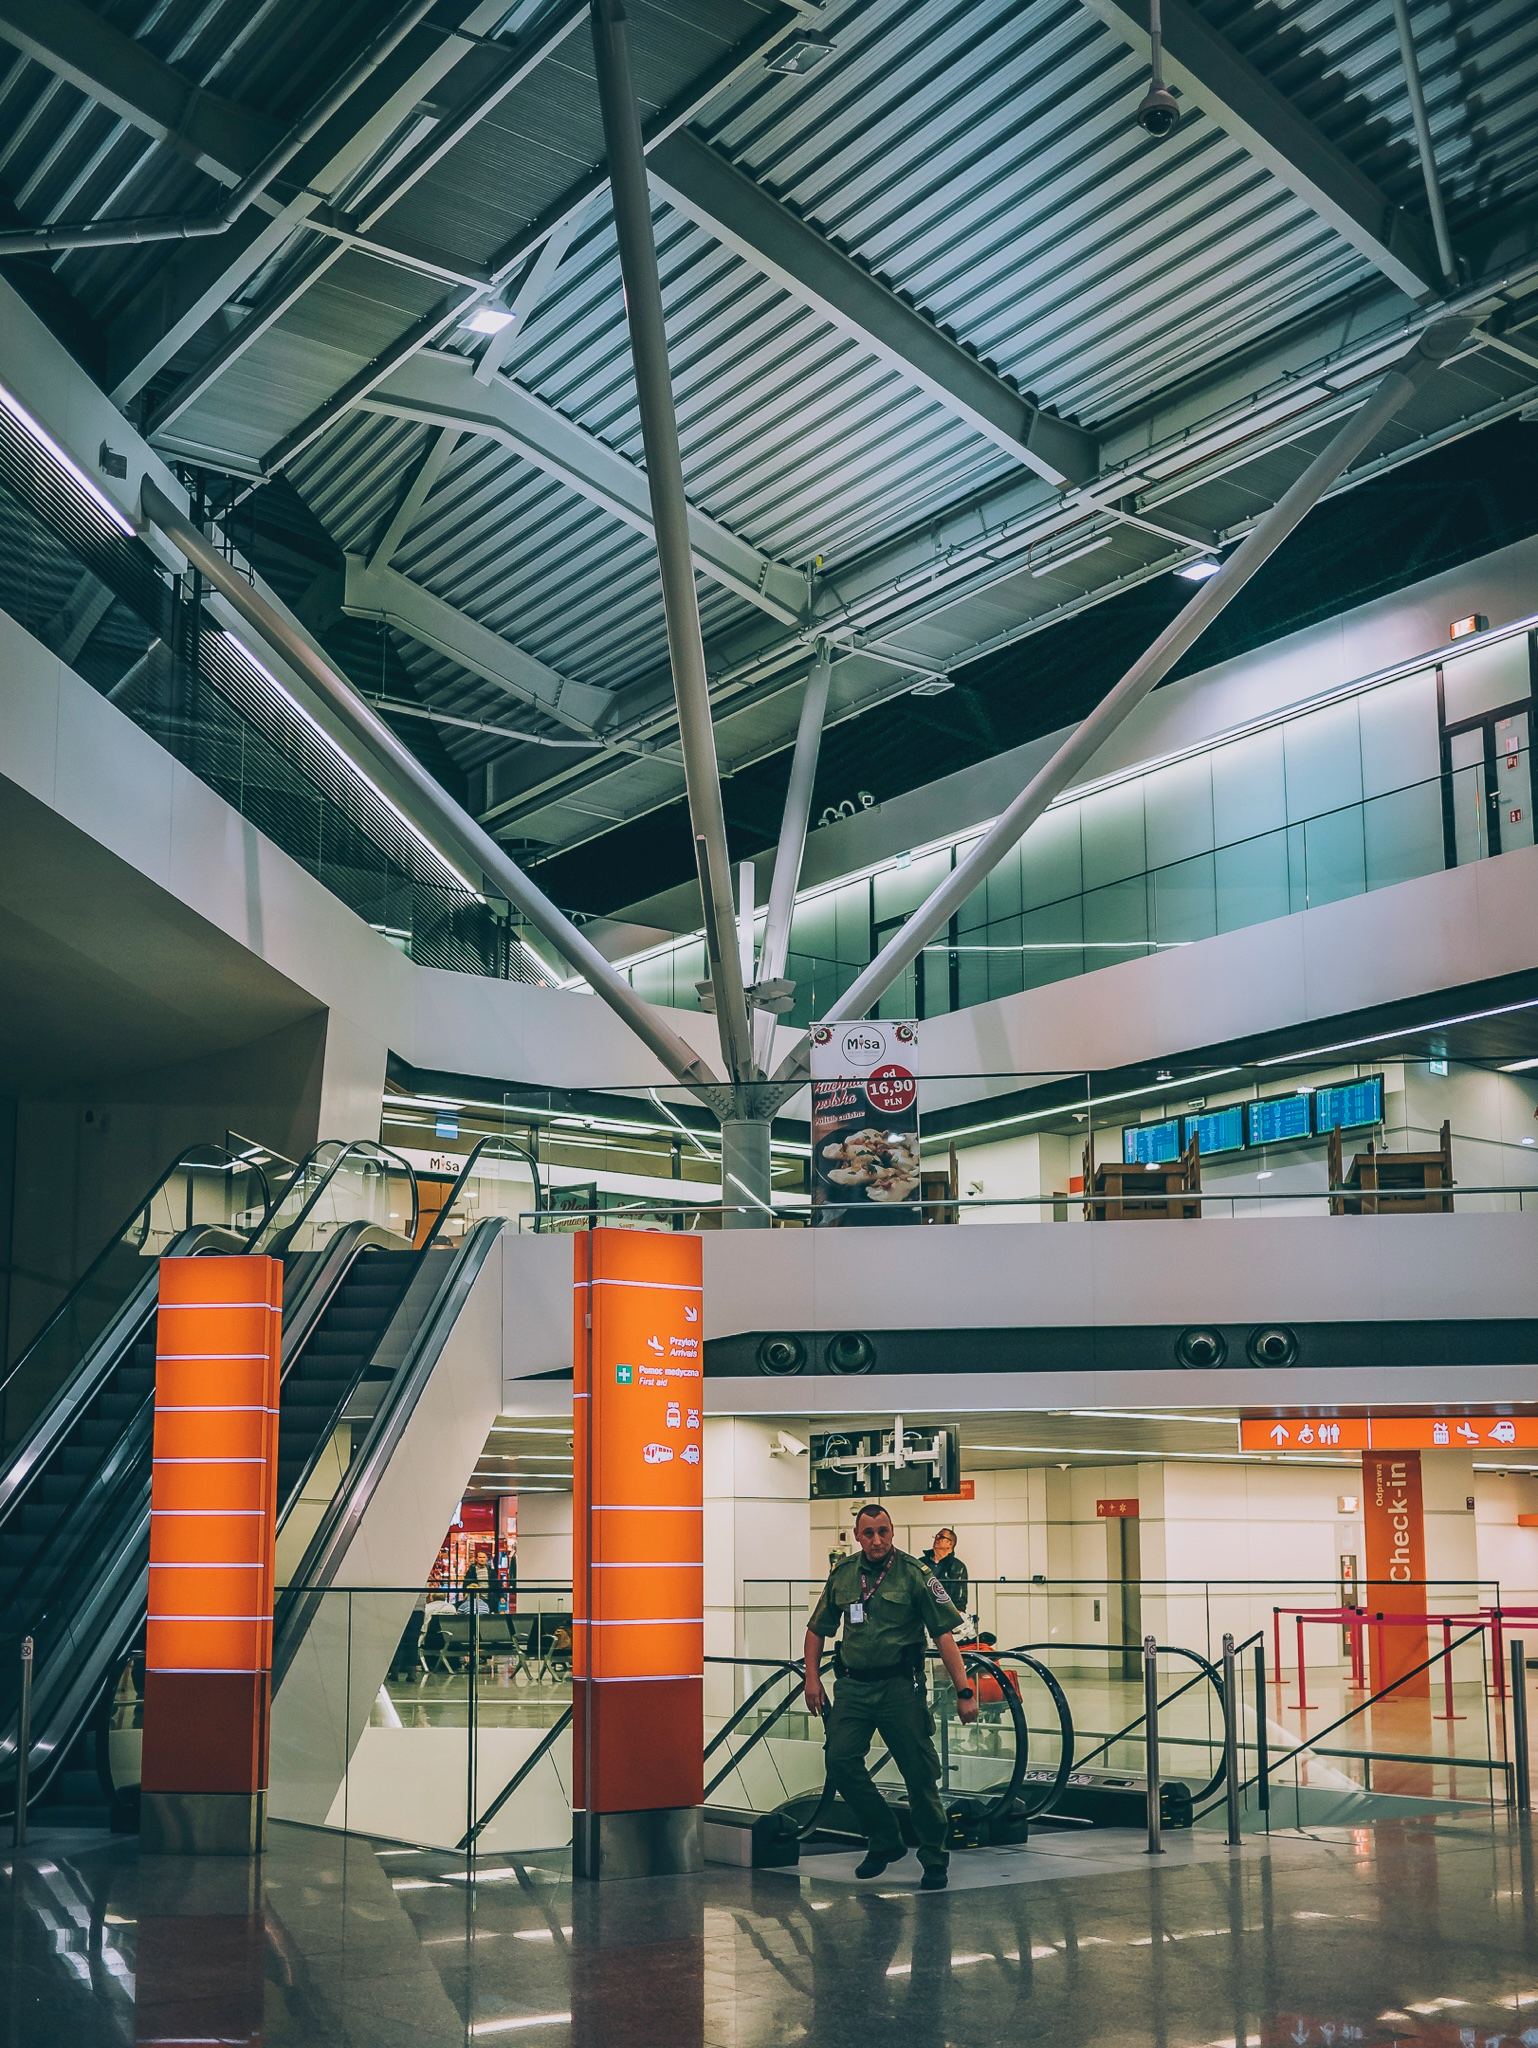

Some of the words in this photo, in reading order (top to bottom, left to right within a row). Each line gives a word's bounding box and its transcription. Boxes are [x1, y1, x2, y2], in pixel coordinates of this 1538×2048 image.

[847, 1034, 880, 1050] Misa
[882, 1068, 896, 1078] od
[869, 1079, 913, 1096] 16,90
[884, 1097, 903, 1107] PLN
[430, 1155, 460, 1172] Misa
[669, 1347, 698, 1358] Arrivals
[638, 1365, 663, 1375] Pomoc
[664, 1367, 700, 1378] medyczna
[638, 1376, 655, 1386] First
[655, 1378, 668, 1387] aid
[1375, 1463, 1385, 1507] Odprawa
[1386, 1462, 1412, 1581] Check-in
